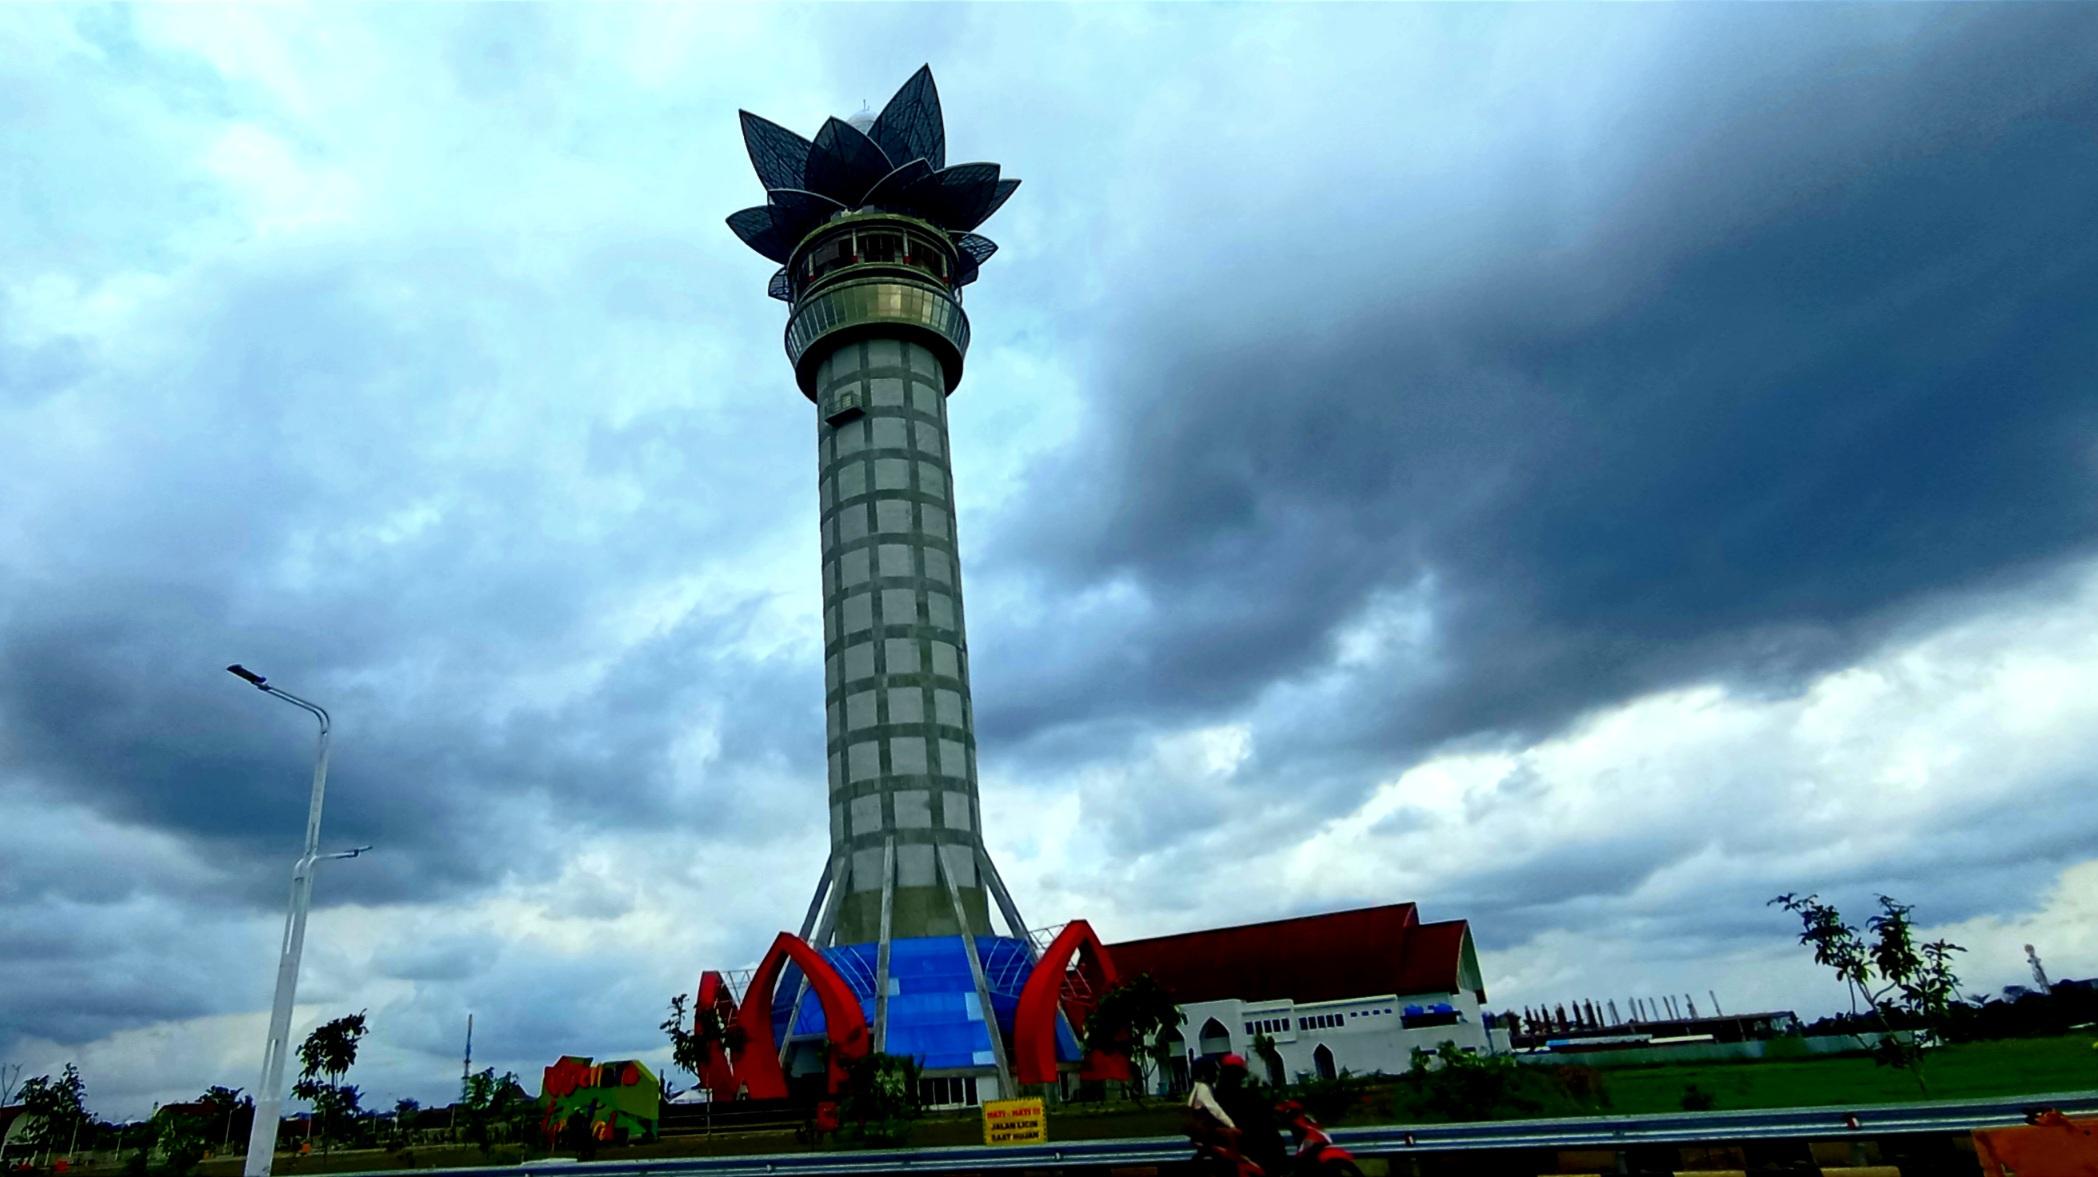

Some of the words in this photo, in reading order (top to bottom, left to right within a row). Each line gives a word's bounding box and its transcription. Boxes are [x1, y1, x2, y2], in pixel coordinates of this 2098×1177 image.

[987, 1110, 1006, 1119] HATI
[1012, 1107, 1031, 1117] HATI
[991, 1122, 1016, 1130] JALAN
[1017, 1120, 1038, 1129] LICIN
[992, 1133, 1011, 1142] SAAT
[1012, 1131, 1039, 1140] HUJAN
